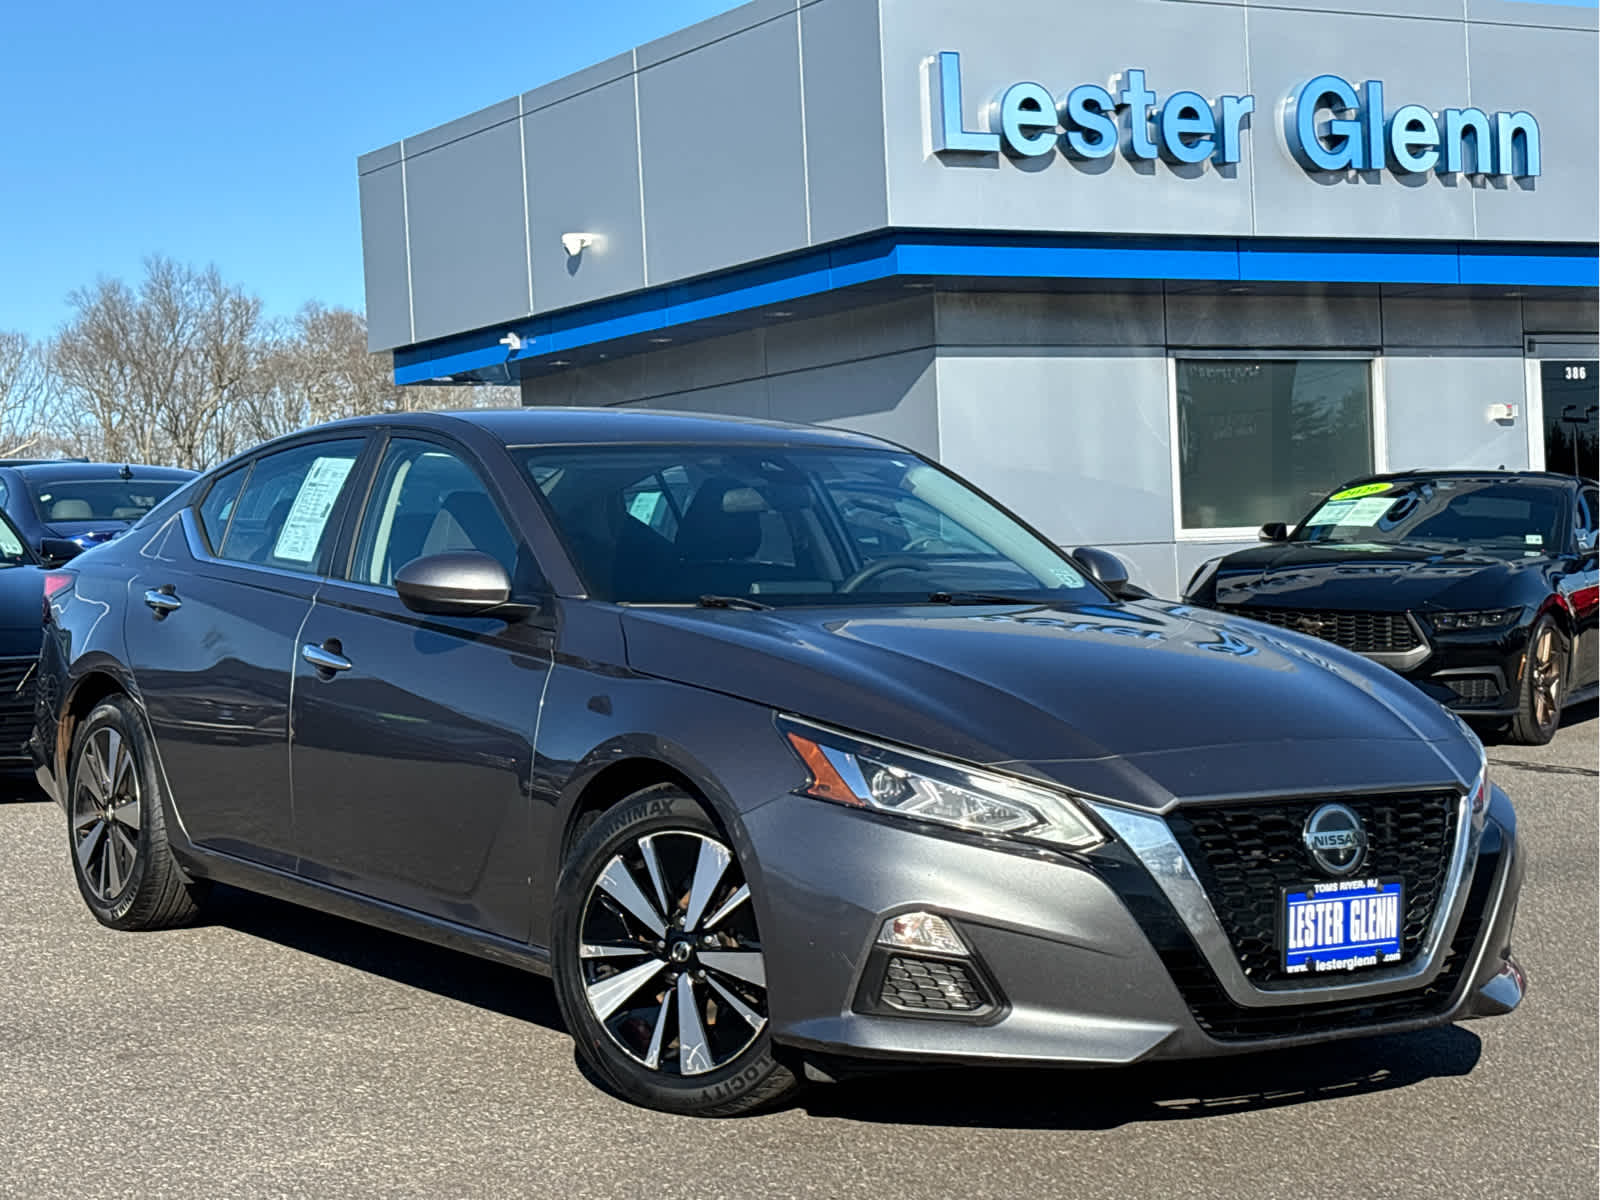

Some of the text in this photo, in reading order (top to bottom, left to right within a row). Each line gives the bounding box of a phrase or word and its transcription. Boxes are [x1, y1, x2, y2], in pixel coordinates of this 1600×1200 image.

[935, 51, 1542, 177] Lester Glenn
[1565, 366, 1586, 380] 386
[1311, 833, 1365, 848] NISSAN
[1314, 882, 1338, 893] TOMS
[1367, 878, 1378, 888] NJ
[1288, 896, 1398, 949] LESTER GLENN
[1315, 956, 1377, 971] lesterglenn
